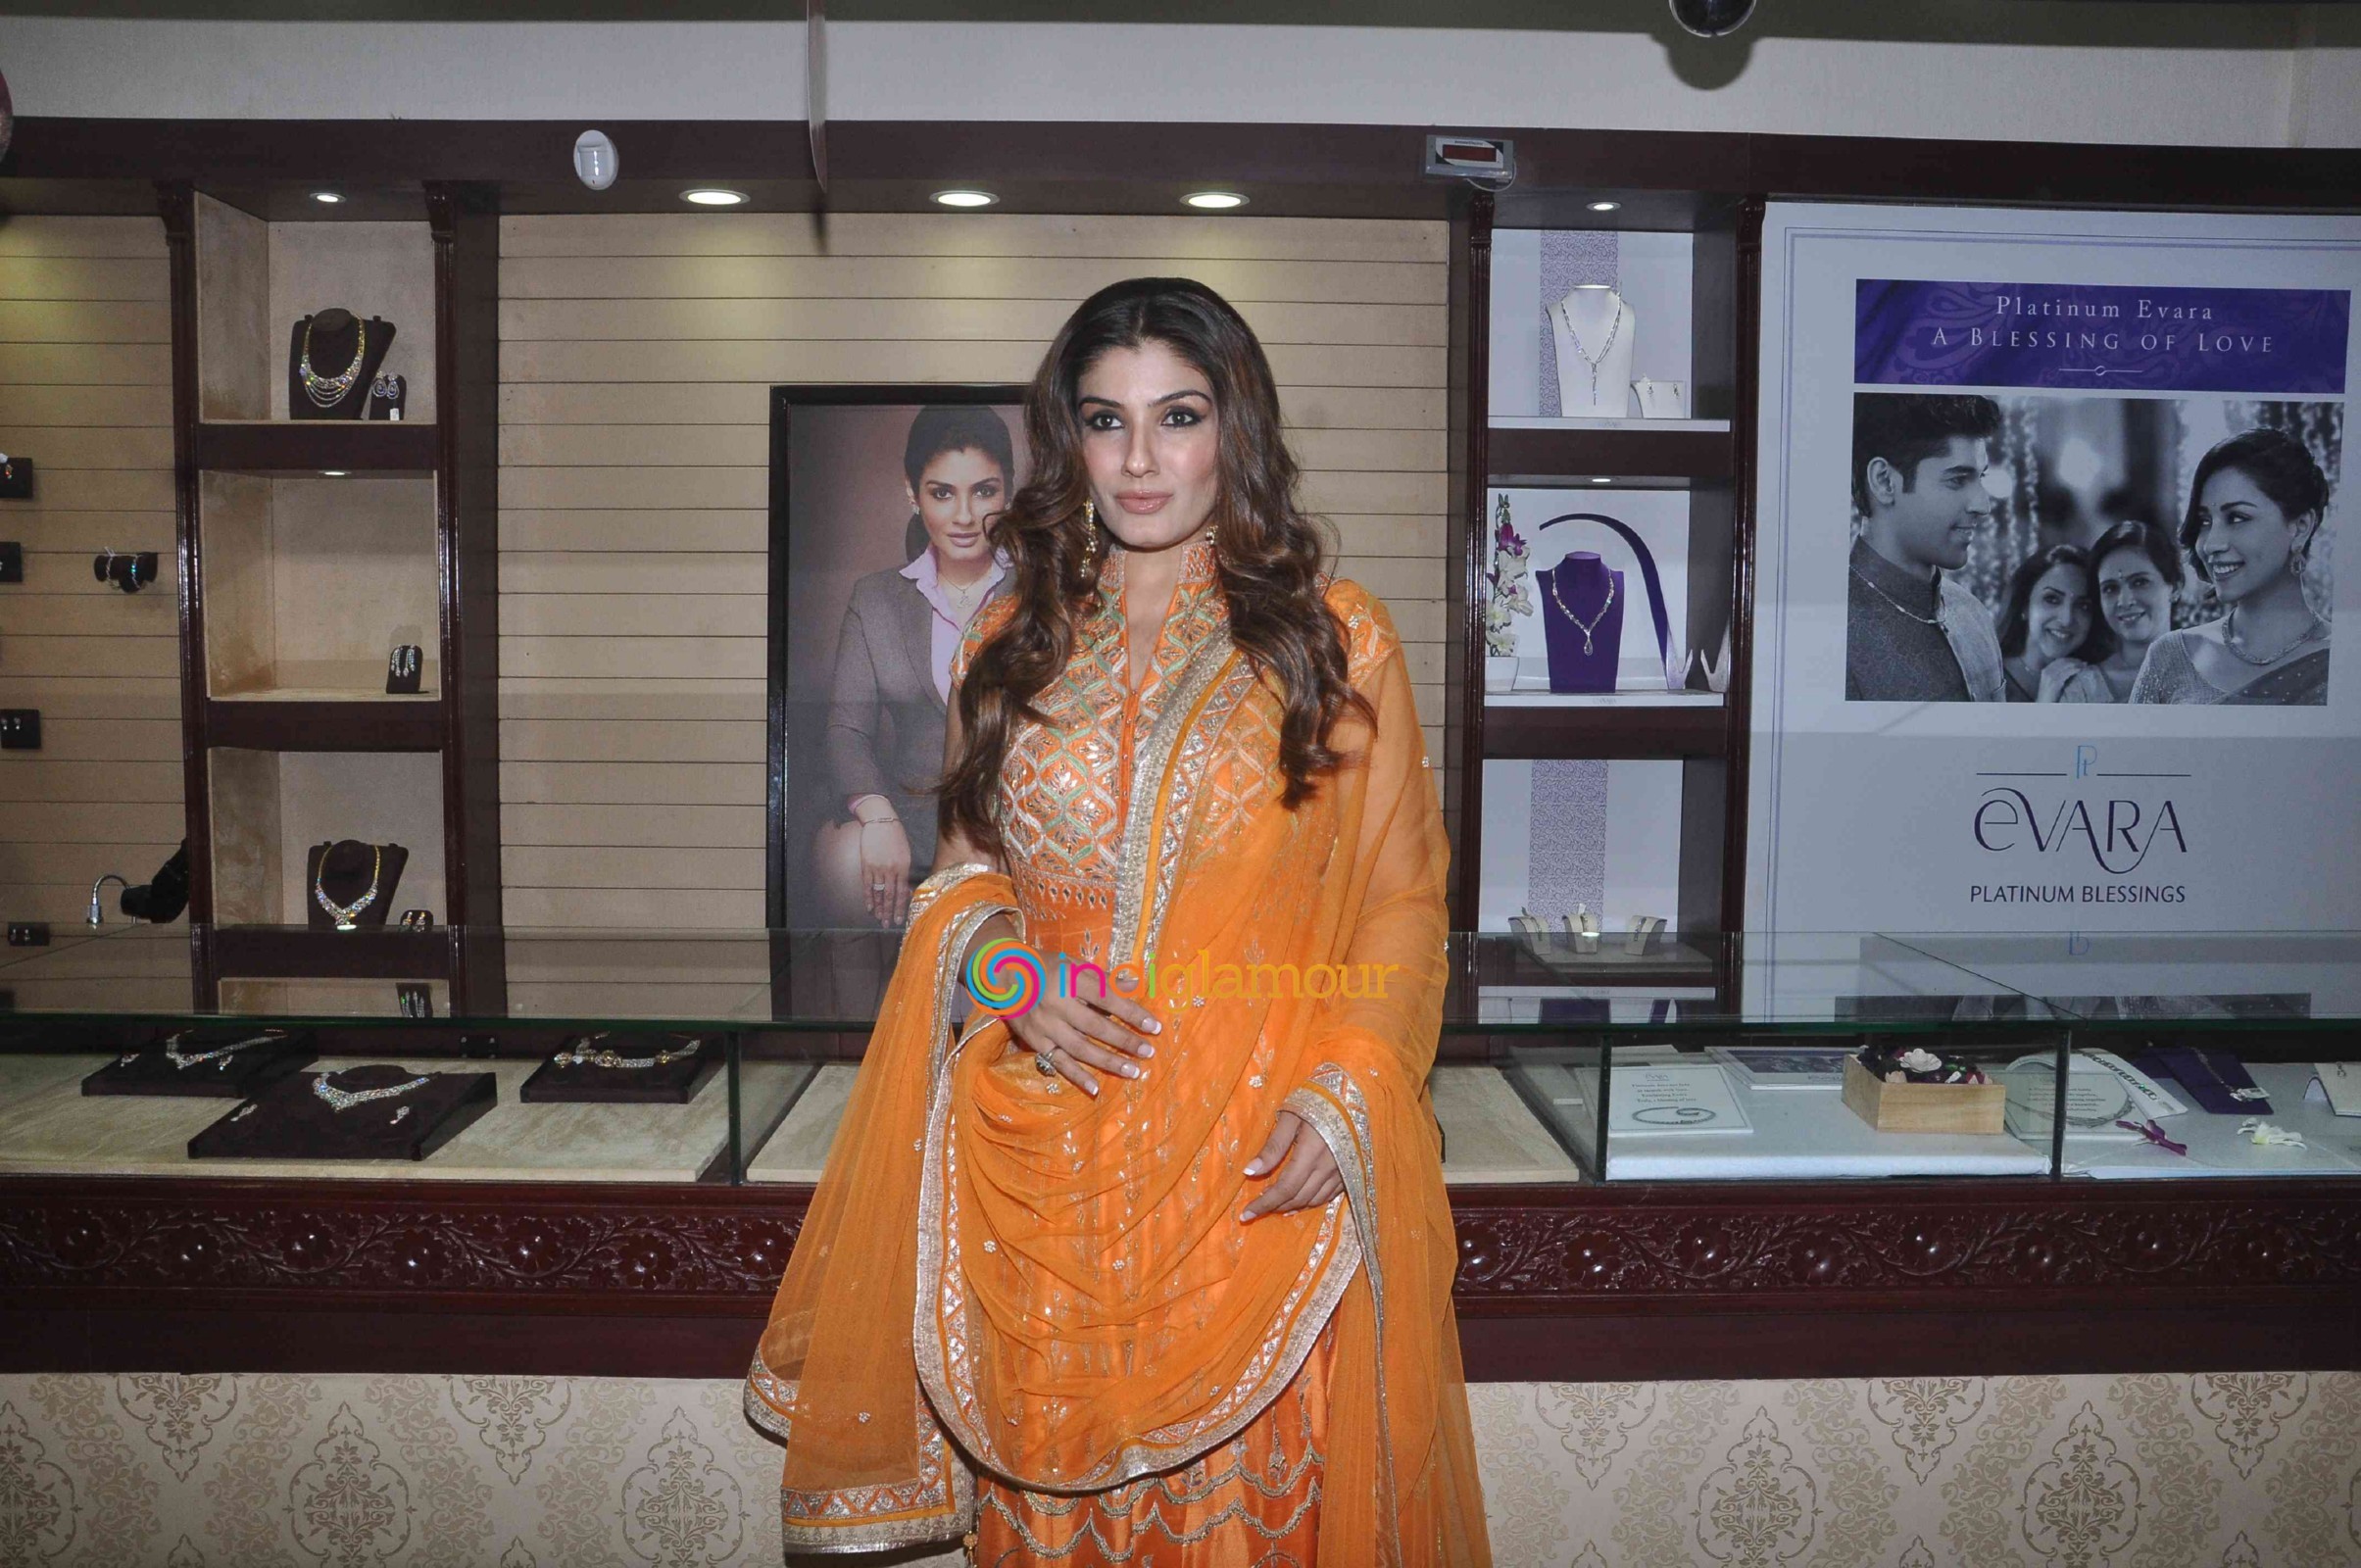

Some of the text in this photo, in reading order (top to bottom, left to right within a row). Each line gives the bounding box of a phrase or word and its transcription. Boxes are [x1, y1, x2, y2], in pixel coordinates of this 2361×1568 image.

[1996, 296, 2213, 320] Platinum Evara
[1933, 326, 1948, 346] A
[1970, 327, 2120, 350] BLESSING
[2198, 333, 2273, 353] LOVE
[1970, 885, 2187, 904] PLATINUM BLESSINGS
